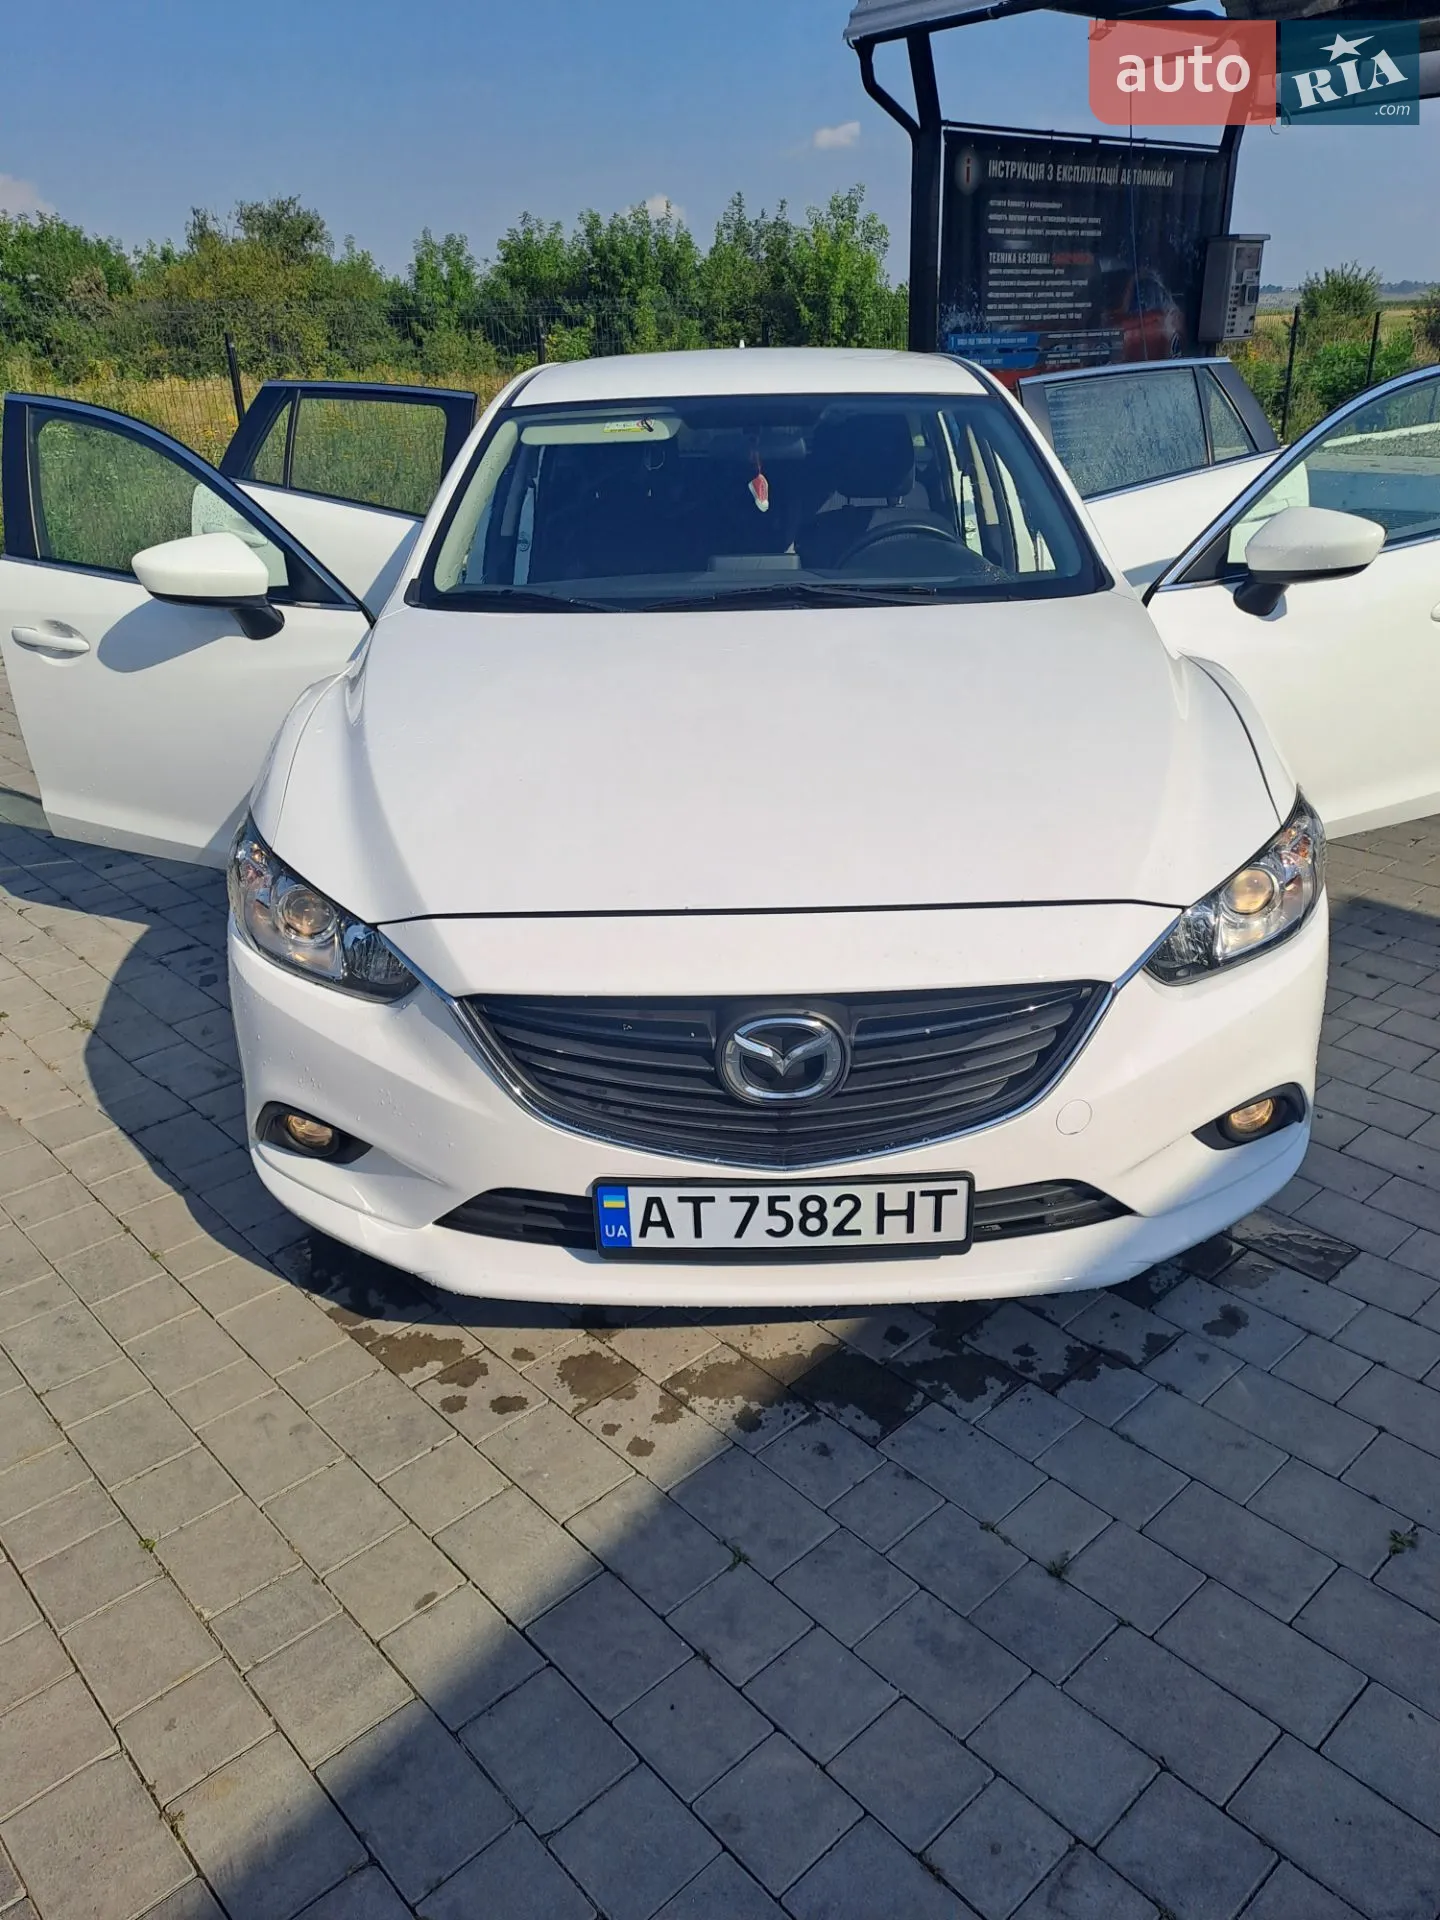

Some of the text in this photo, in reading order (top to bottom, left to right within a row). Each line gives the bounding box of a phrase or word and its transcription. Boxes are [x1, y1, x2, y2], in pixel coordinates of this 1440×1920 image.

[988, 159, 1045, 180] ІНСТРУКЦІЯ
[1056, 164, 1119, 185] ЕКСПЛУАТАЦІЇ
[989, 252, 1017, 264] ТЕХНІКА
[638, 1188, 958, 1239] AT 7582 HT
[604, 1224, 628, 1238] UA
